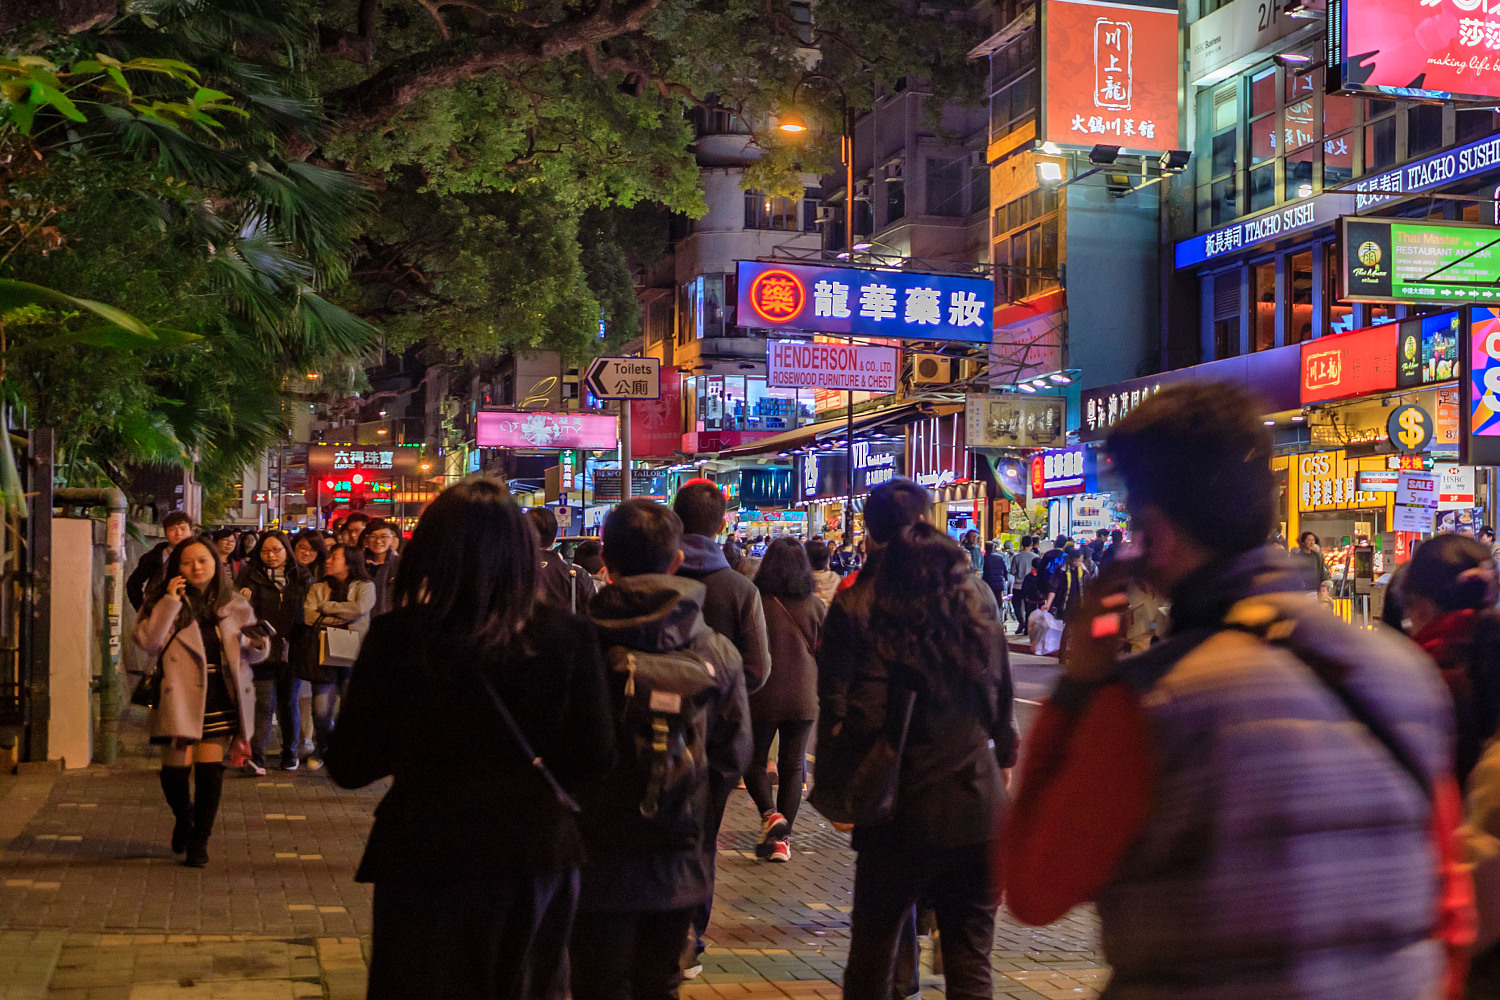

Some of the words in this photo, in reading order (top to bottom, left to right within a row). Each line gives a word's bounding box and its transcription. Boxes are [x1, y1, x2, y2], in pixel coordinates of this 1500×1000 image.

[1100, 28, 1128, 101] 川上龍
[1427, 53, 1468, 75] making
[1469, 56, 1491, 76] life
[1071, 114, 1156, 140] 火鍋川菜館
[1357, 170, 1402, 208] 板長寿司
[1407, 156, 1455, 190] ITACHO
[1459, 139, 1500, 173] SUSHI
[1205, 225, 1242, 256] 板長寿司
[1244, 210, 1281, 243] ITACHO
[1283, 201, 1315, 229] SUSHI
[1395, 231, 1421, 243] Thai
[1423, 233, 1461, 245] Master
[1396, 245, 1453, 256] RESTAURANT
[1455, 249, 1473, 257] AND
[762, 277, 795, 315] 藥
[813, 281, 985, 327] 龍華藥妝
[614, 363, 652, 375] Toilets
[774, 345, 858, 371] HENDERSON
[880, 362, 893, 372] LTD.
[1310, 357, 1338, 382] 川上龍
[615, 380, 648, 395] 公廁
[773, 371, 816, 385] ROSEWOOD
[818, 373, 859, 387] FURNITURE
[861, 375, 866, 387] &
[868, 375, 892, 388] CHEST
[334, 451, 394, 465] 六福珠寶
[852, 442, 870, 469] VIP
[1301, 455, 1330, 476] CSS
[1408, 480, 1433, 490] SALE
[1410, 492, 1417, 502] 5
